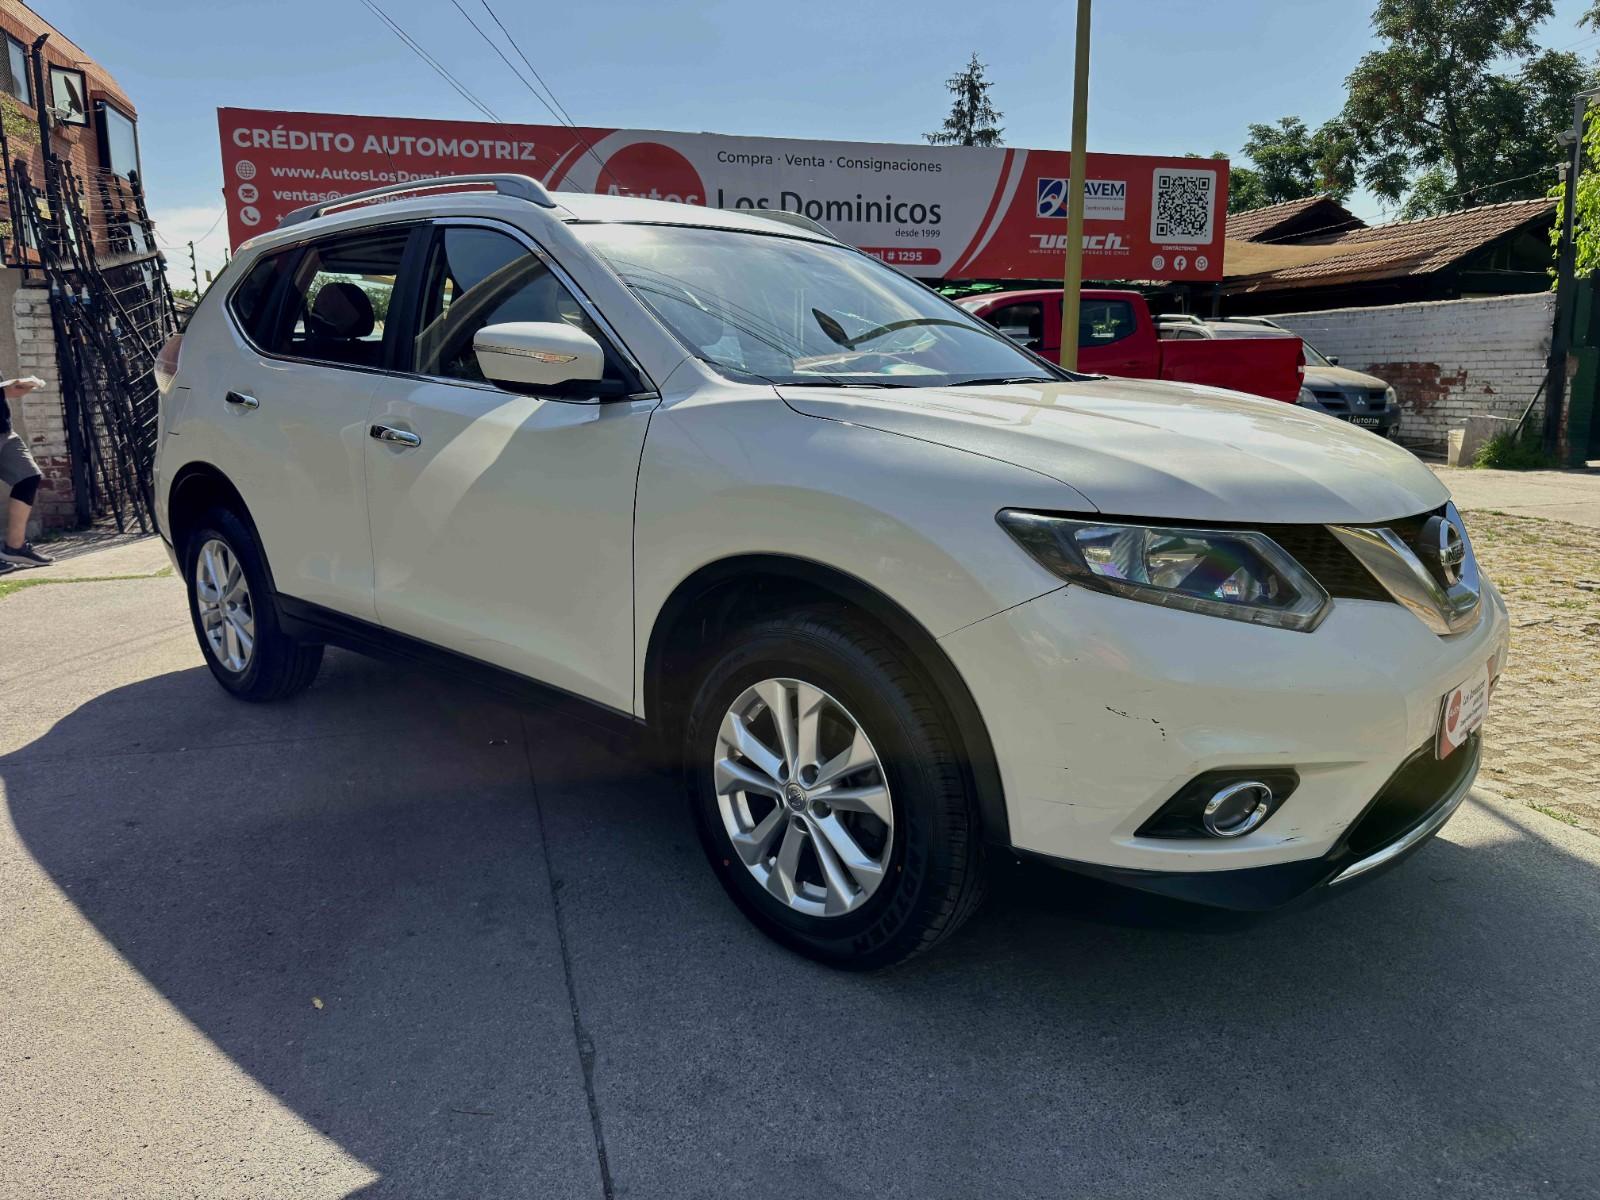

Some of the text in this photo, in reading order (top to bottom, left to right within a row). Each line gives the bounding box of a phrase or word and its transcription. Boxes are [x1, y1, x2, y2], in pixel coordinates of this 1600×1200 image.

[232, 125, 537, 161] CRÉDITO AUTOMOTRIZ
[717, 150, 943, 173] Compra Venta Consignaciones
[1084, 182, 1125, 196] AVEM
[780, 190, 943, 225] Dominicos
[895, 228, 941, 238] desde 1999
[898, 251, 922, 261] 1295
